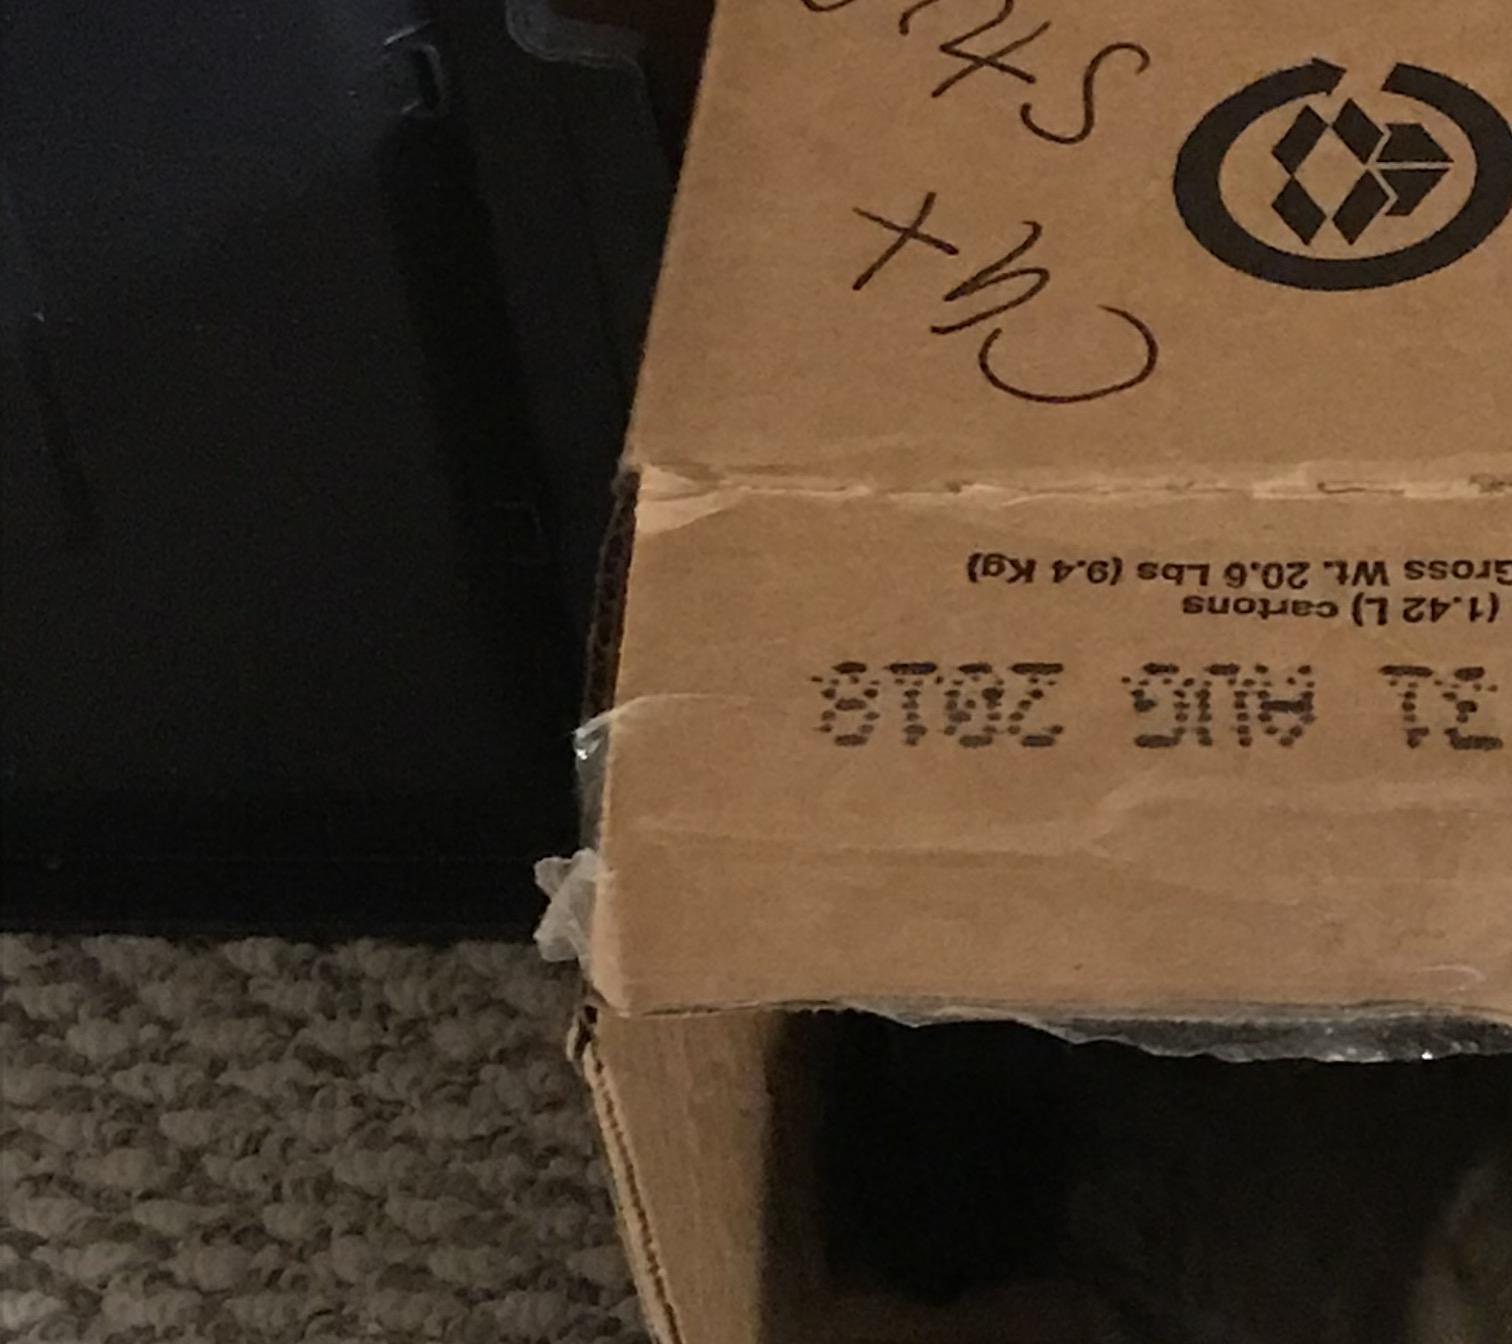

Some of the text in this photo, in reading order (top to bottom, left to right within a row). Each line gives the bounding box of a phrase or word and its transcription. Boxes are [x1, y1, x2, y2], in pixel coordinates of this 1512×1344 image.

[967, 552, 1037, 584] Kg)
[1051, 555, 1123, 587] (9.4
[1136, 559, 1210, 586] Lbs
[1223, 560, 1308, 588] 20.6
[1323, 560, 1391, 587] Wt.
[1182, 593, 1340, 620] cartons
[1352, 592, 1389, 626] L)
[1403, 592, 1500, 625] (1.42
[809, 660, 1065, 749] 2018
[1119, 661, 1317, 748] AUG
[1376, 663, 1504, 752] 31
